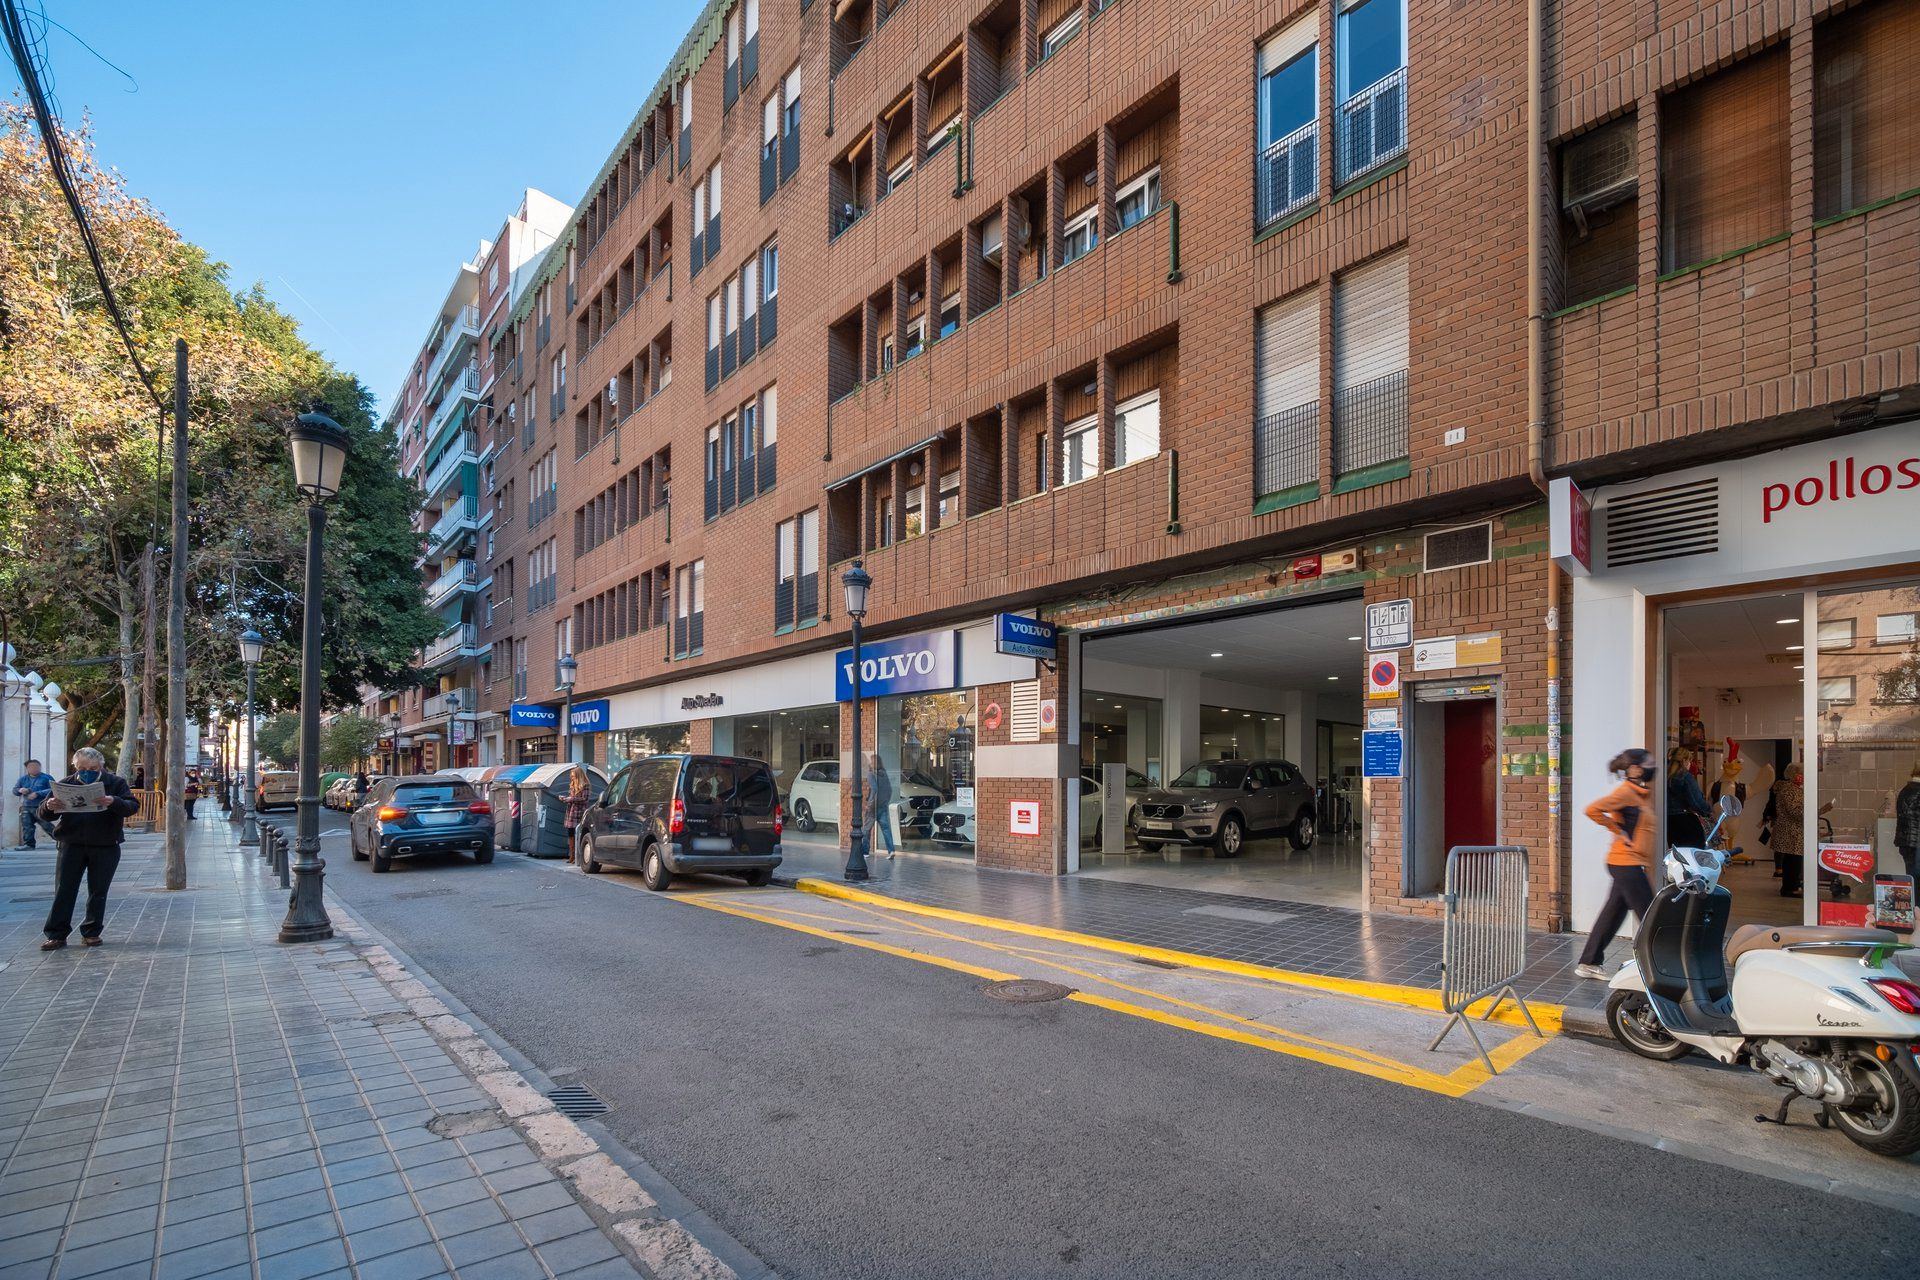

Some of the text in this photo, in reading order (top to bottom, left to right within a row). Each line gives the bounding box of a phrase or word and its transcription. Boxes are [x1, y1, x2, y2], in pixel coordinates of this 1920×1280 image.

[1763, 457, 1920, 523] pollos
[1009, 622, 1051, 638] VOLVO
[844, 650, 935, 684] VOLVO
[517, 711, 555, 719] VOLVO
[571, 709, 600, 726] VOLVO
[1834, 857, 1861, 867] Online
[1835, 850, 1862, 861] Tienda
[1816, 1013, 1863, 1027] Vespa
